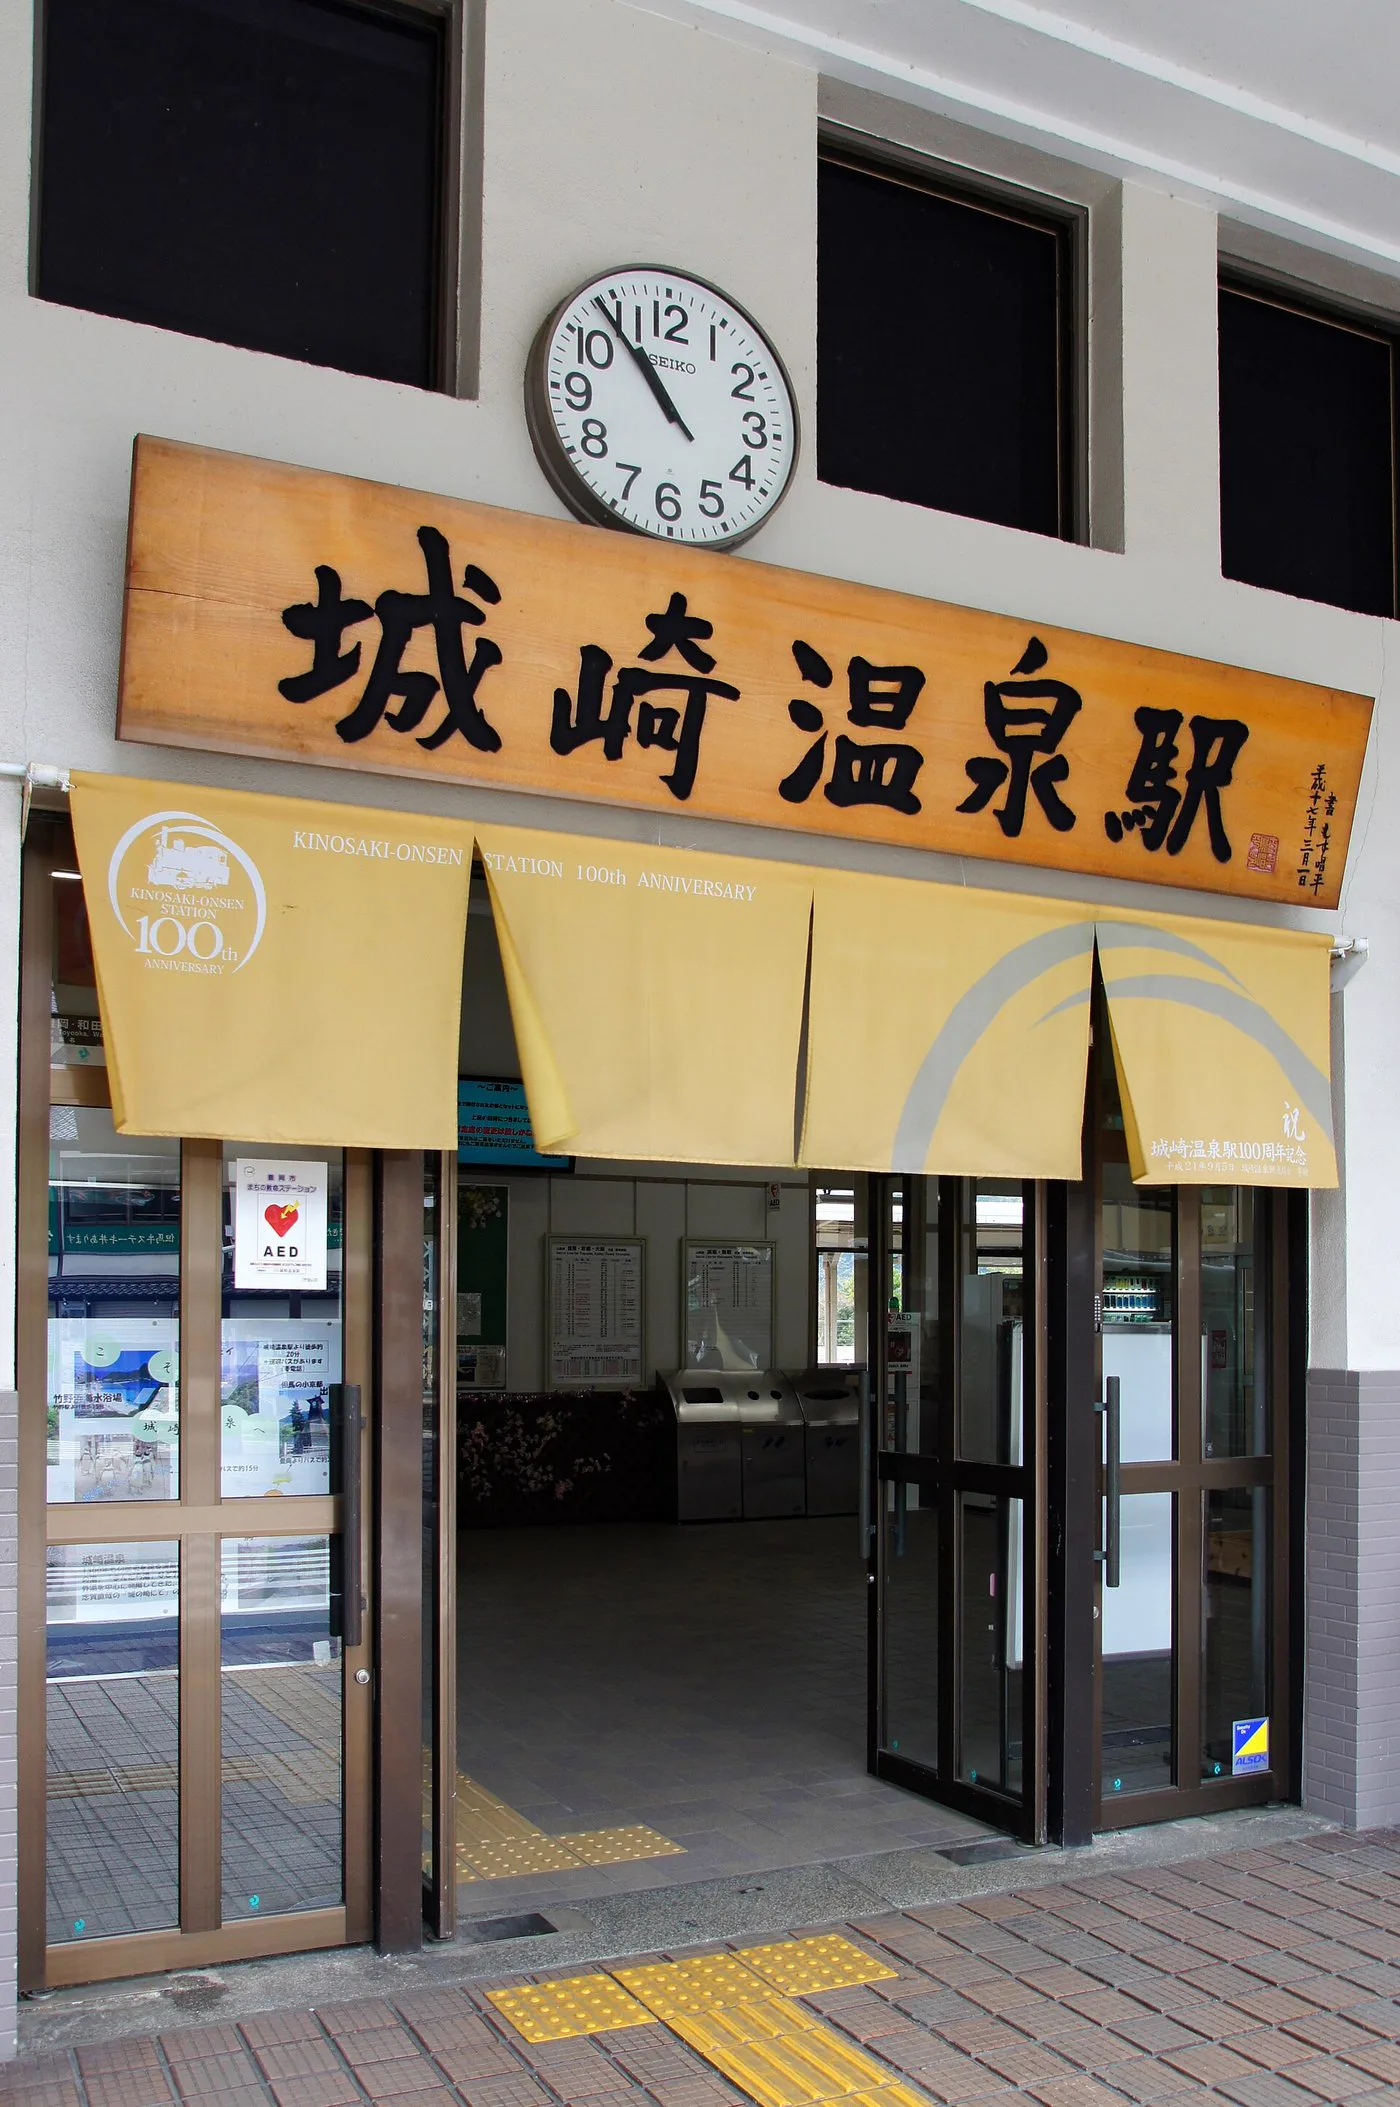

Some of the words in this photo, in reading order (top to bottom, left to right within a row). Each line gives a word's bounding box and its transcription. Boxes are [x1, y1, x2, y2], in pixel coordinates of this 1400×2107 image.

[653, 300, 689, 345] 12
[576, 326, 615, 370] 10
[709, 324, 716, 361] 1
[648, 353, 697, 375] SEIKO
[730, 362, 755, 402] 2
[564, 371, 593, 412] 9
[580, 418, 609, 459] 8
[741, 411, 768, 450] 3
[615, 461, 642, 500] 7
[728, 454, 756, 491] 4
[654, 482, 682, 522] 6
[698, 479, 725, 518] 5
[278, 525, 1249, 864] 城崎温泉駅
[293, 831, 464, 865] KINOSAKI-ONSEN
[484, 852, 564, 878] STATION
[576, 865, 627, 886] 100th
[637, 871, 757, 901] ANNIVERSARY
[130, 887, 245, 910] KINOSAKI-ONSEN
[160, 903, 217, 920] STATION
[135, 916, 238, 962] 100th
[144, 958, 225, 975] ANNIVERSARY
[1150, 1138, 1307, 1165] 城崎温泉駅100周年記念
[263, 1245, 298, 1258] AED
[896, 1313, 912, 1321] AED
[1235, 1755, 1266, 1766] ALSOK
